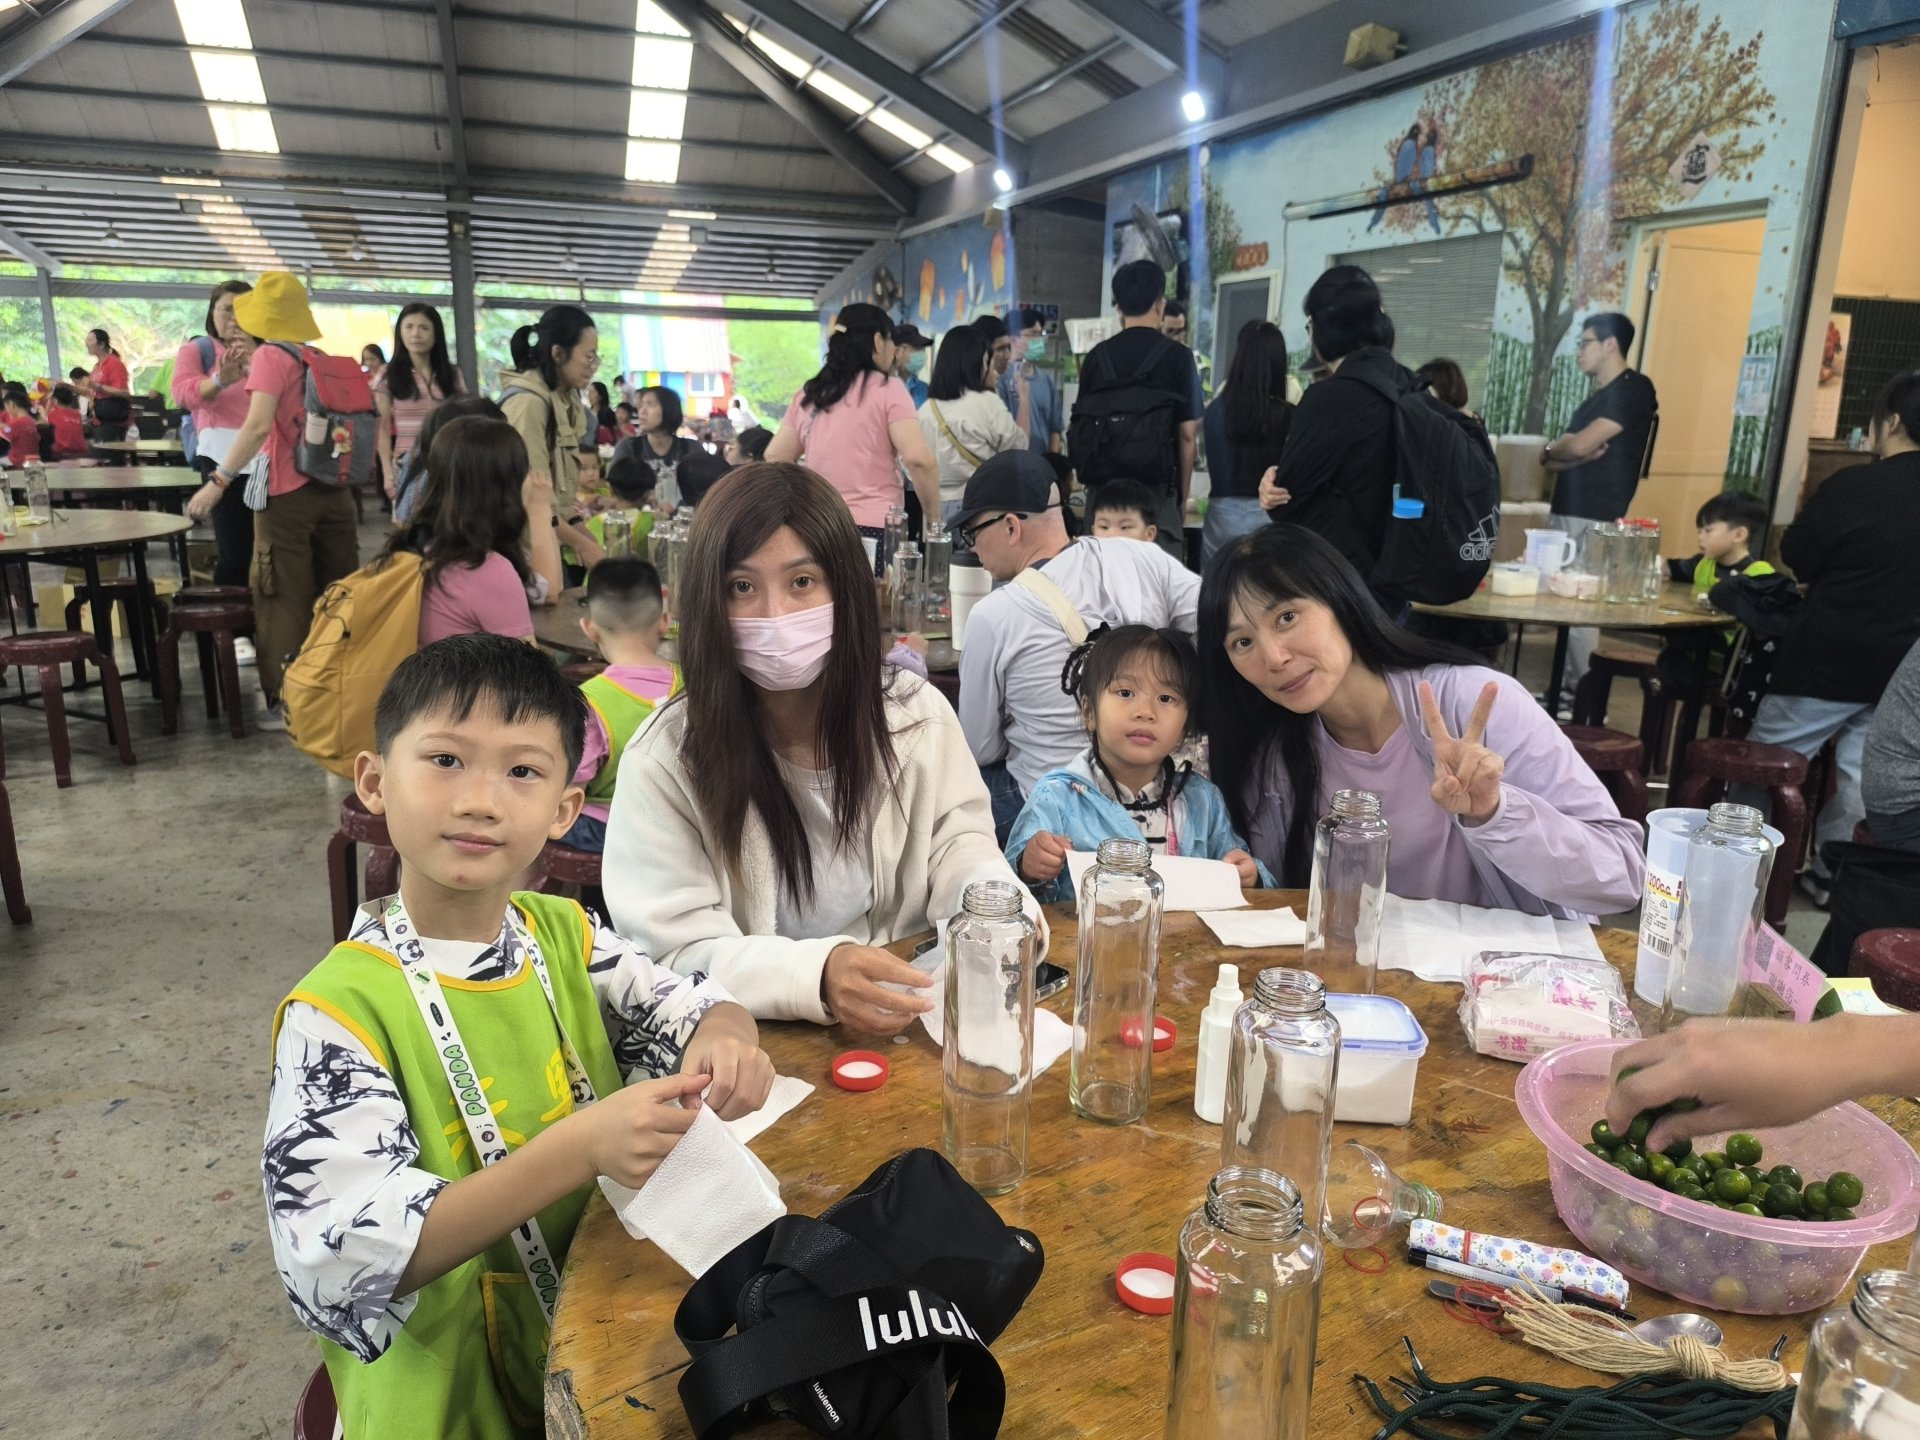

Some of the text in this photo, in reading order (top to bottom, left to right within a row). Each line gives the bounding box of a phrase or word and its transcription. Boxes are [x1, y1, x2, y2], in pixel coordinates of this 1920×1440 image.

[443, 1044, 487, 1116] PANDA
[858, 1289, 989, 1352] lulul
[812, 1381, 840, 1423] lululemon
